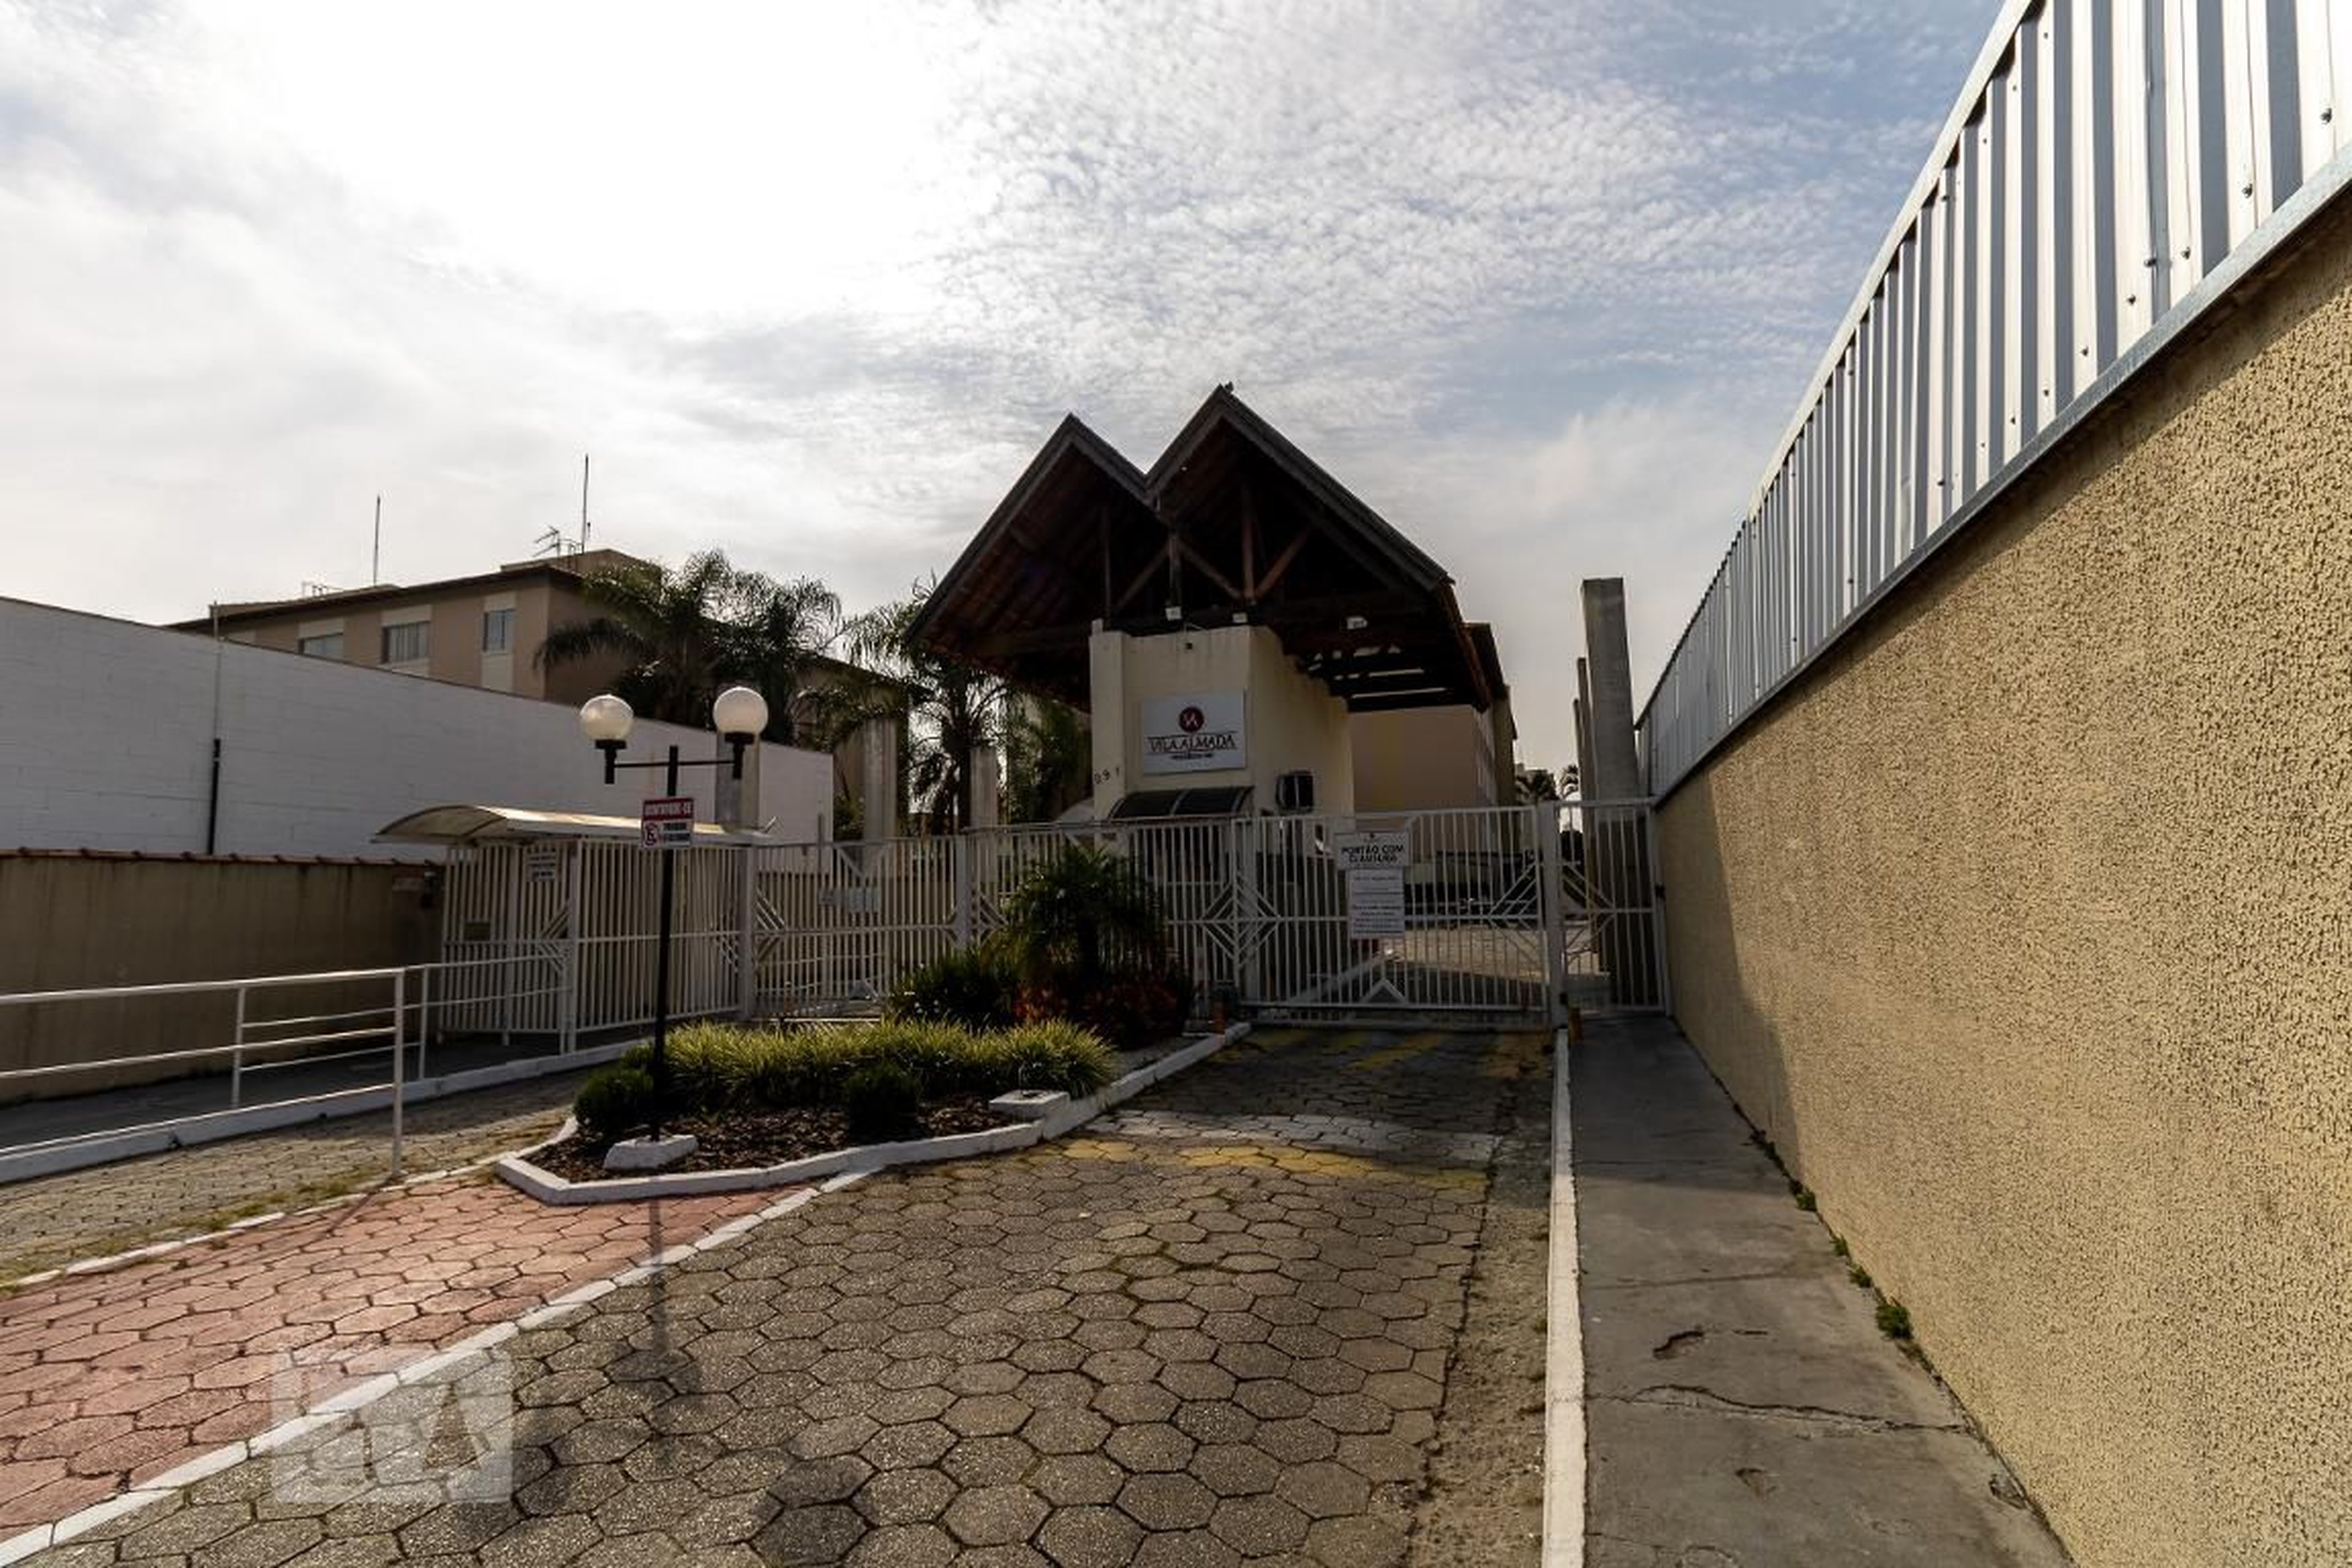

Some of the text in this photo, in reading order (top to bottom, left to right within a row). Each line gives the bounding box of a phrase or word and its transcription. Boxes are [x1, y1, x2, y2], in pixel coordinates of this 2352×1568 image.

[1150, 734, 1235, 752] VILA ALMADA
[1341, 844, 1404, 855] PORTÃO COM
